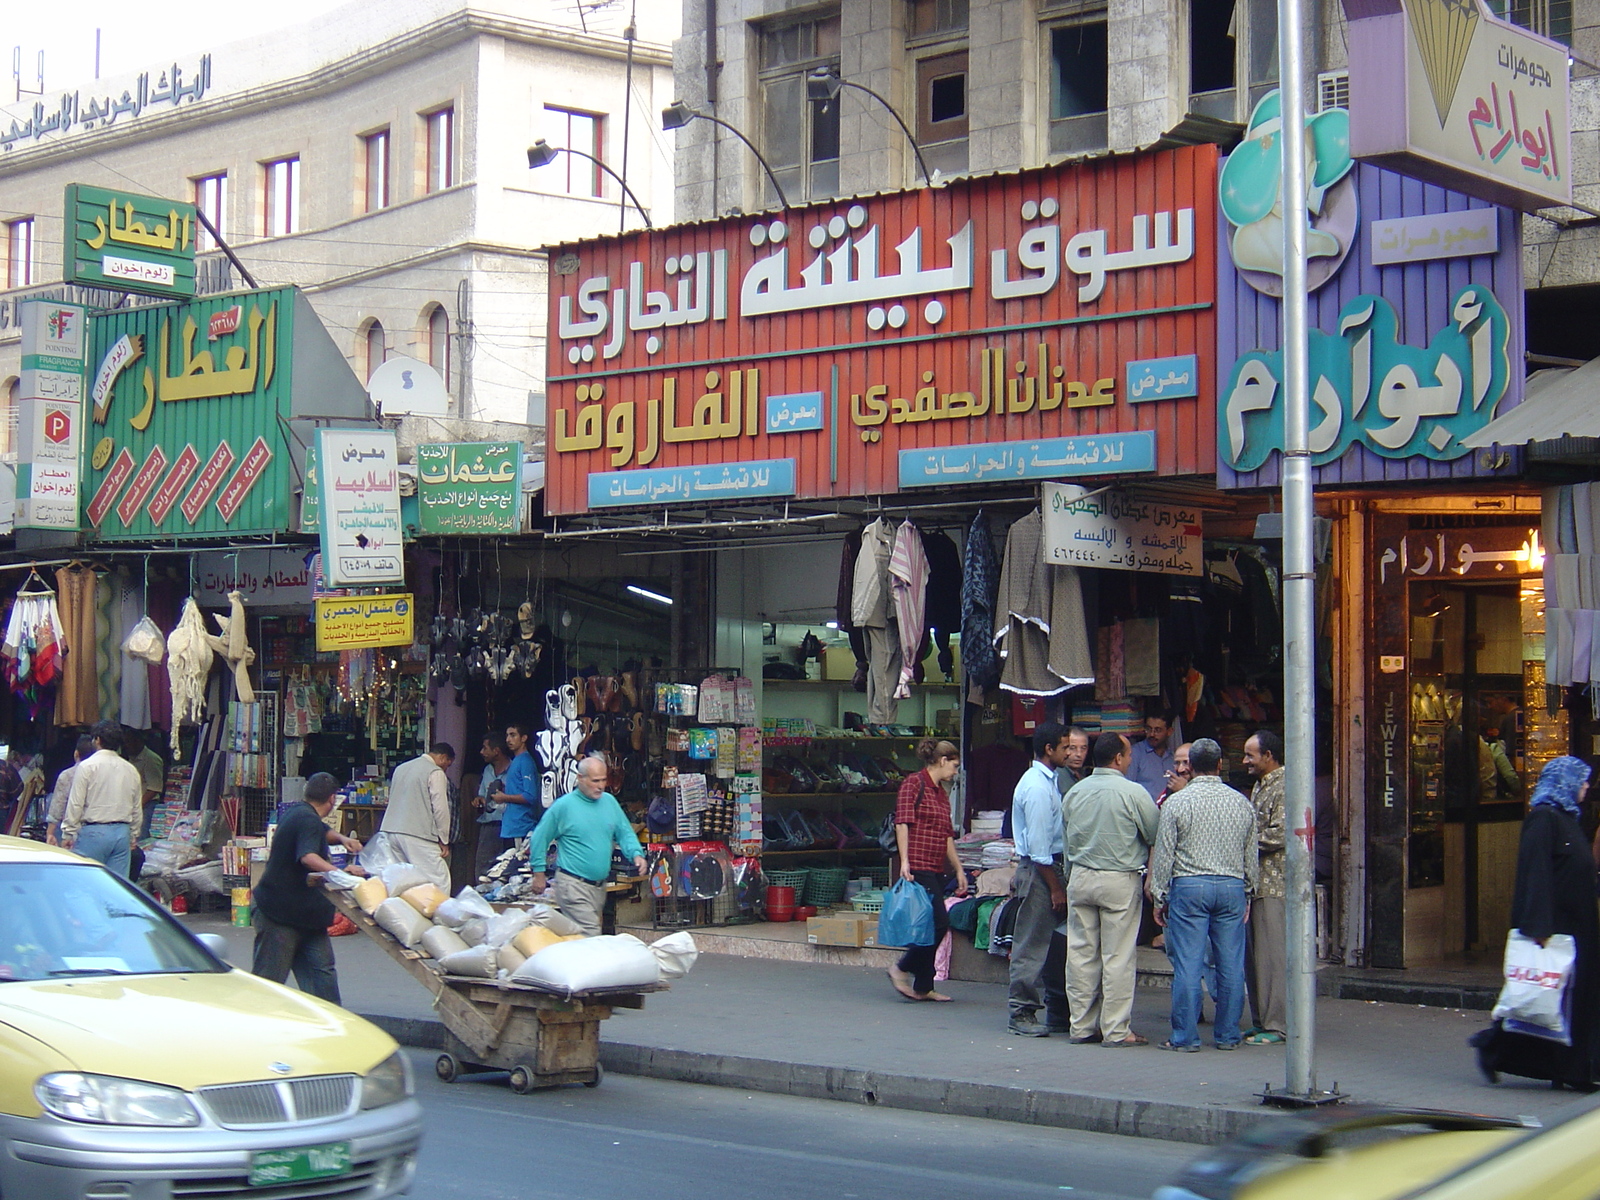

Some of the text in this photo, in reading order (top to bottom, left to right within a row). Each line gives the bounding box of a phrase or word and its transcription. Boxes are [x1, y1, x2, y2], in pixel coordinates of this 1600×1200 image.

[1498, 43, 1551, 88] مجوهرات
[0, 53, 211, 151] البنك العربي الاسلامي
[86, 198, 190, 252] العطار
[1379, 221, 1489, 252] مجوهرات
[145, 267, 169, 281] زلوم
[193, 257, 232, 294] ANK
[558, 198, 1196, 365] سوق بيشة التجاري
[39, 356, 80, 367] FRAGRANCIA
[45, 344, 77, 354] POINTING
[129, 300, 277, 430] العطار
[851, 342, 1116, 443] عدنان الصفدي
[1131, 369, 1190, 397] معرض
[53, 417, 65, 436] P
[555, 368, 817, 468] معرض الفاروق
[342, 443, 386, 463] معرض
[485, 445, 509, 456] معرض
[1030, 440, 1125, 467] للاقمشة
[39, 469, 71, 478] العطار
[420, 446, 516, 485] عثمان
[58, 483, 77, 497] زلوم
[609, 467, 770, 500] للاقمشة والحرامات
[374, 558, 394, 570] هاتف
[1053, 547, 1101, 563] ٤٦٢٤٤٤٠
[323, 601, 393, 621] مشغل الجعبري
[1380, 691, 1397, 809] JEWELLE
